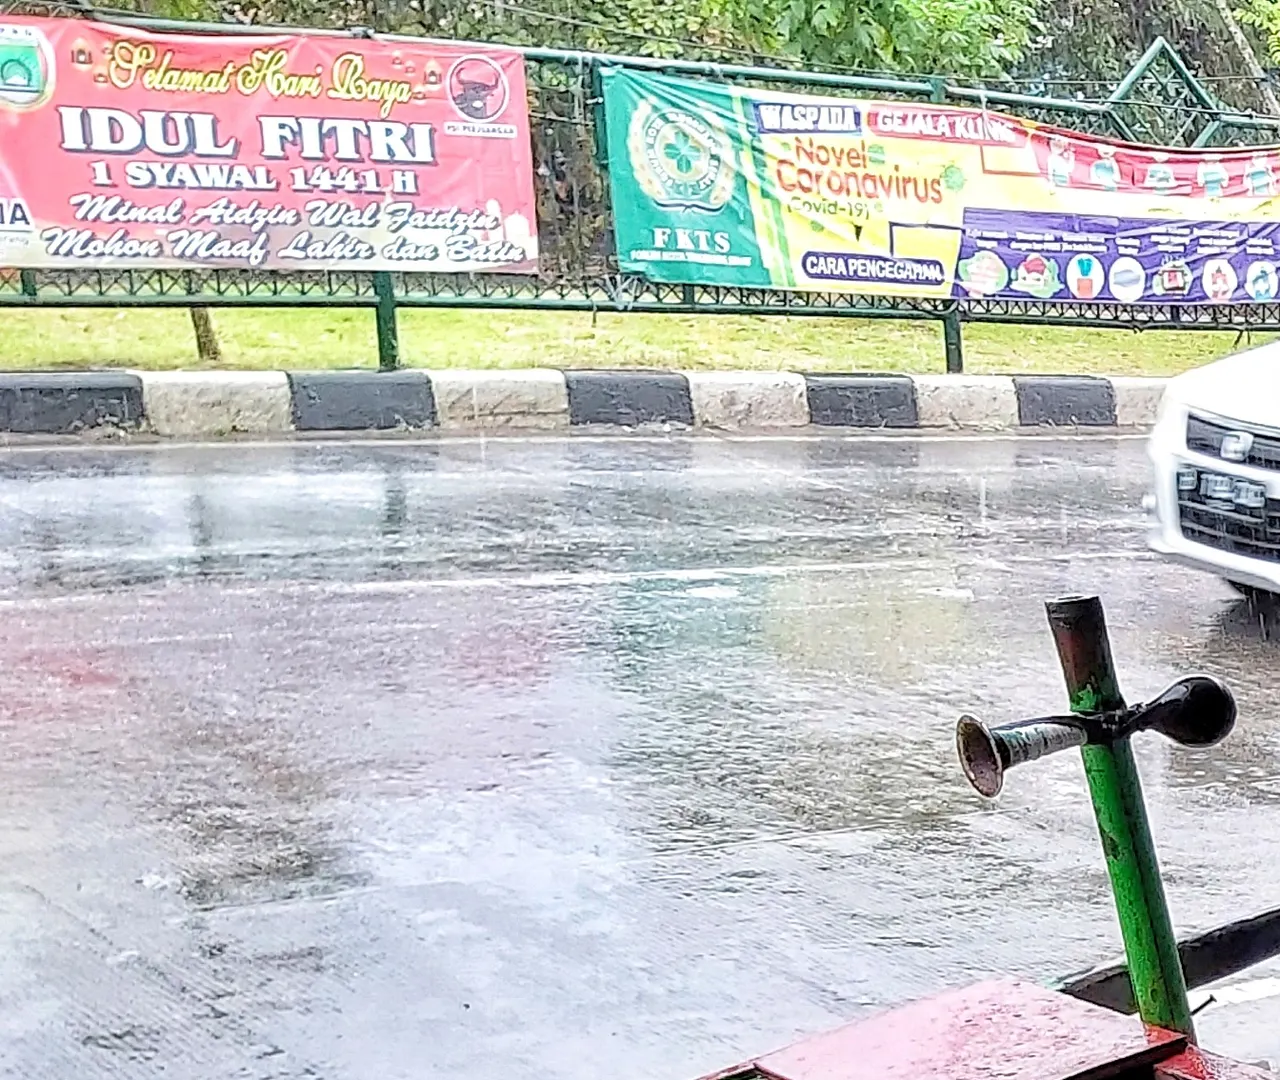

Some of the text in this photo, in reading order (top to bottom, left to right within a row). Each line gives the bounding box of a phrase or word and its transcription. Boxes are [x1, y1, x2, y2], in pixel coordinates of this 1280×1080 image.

[109, 41, 414, 119] Selamat Hari Raya
[758, 104, 857, 131] WASPADA
[877, 110, 950, 136] GEJALA
[58, 106, 437, 164] IDUL FITRI
[795, 136, 868, 169] Novel
[90, 161, 418, 195] 1 SYAWAL 1441 H
[777, 159, 943, 204] Coronavirus
[69, 192, 501, 235] Minal Aidzin Wal Faidzin
[40, 227, 163, 258] Mohon
[166, 229, 269, 266] Maaf
[277, 231, 376, 262] Lahir
[382, 236, 441, 262] dan
[445, 234, 527, 263] Batin
[653, 227, 731, 254] FKTS
[806, 255, 847, 275] CARA
